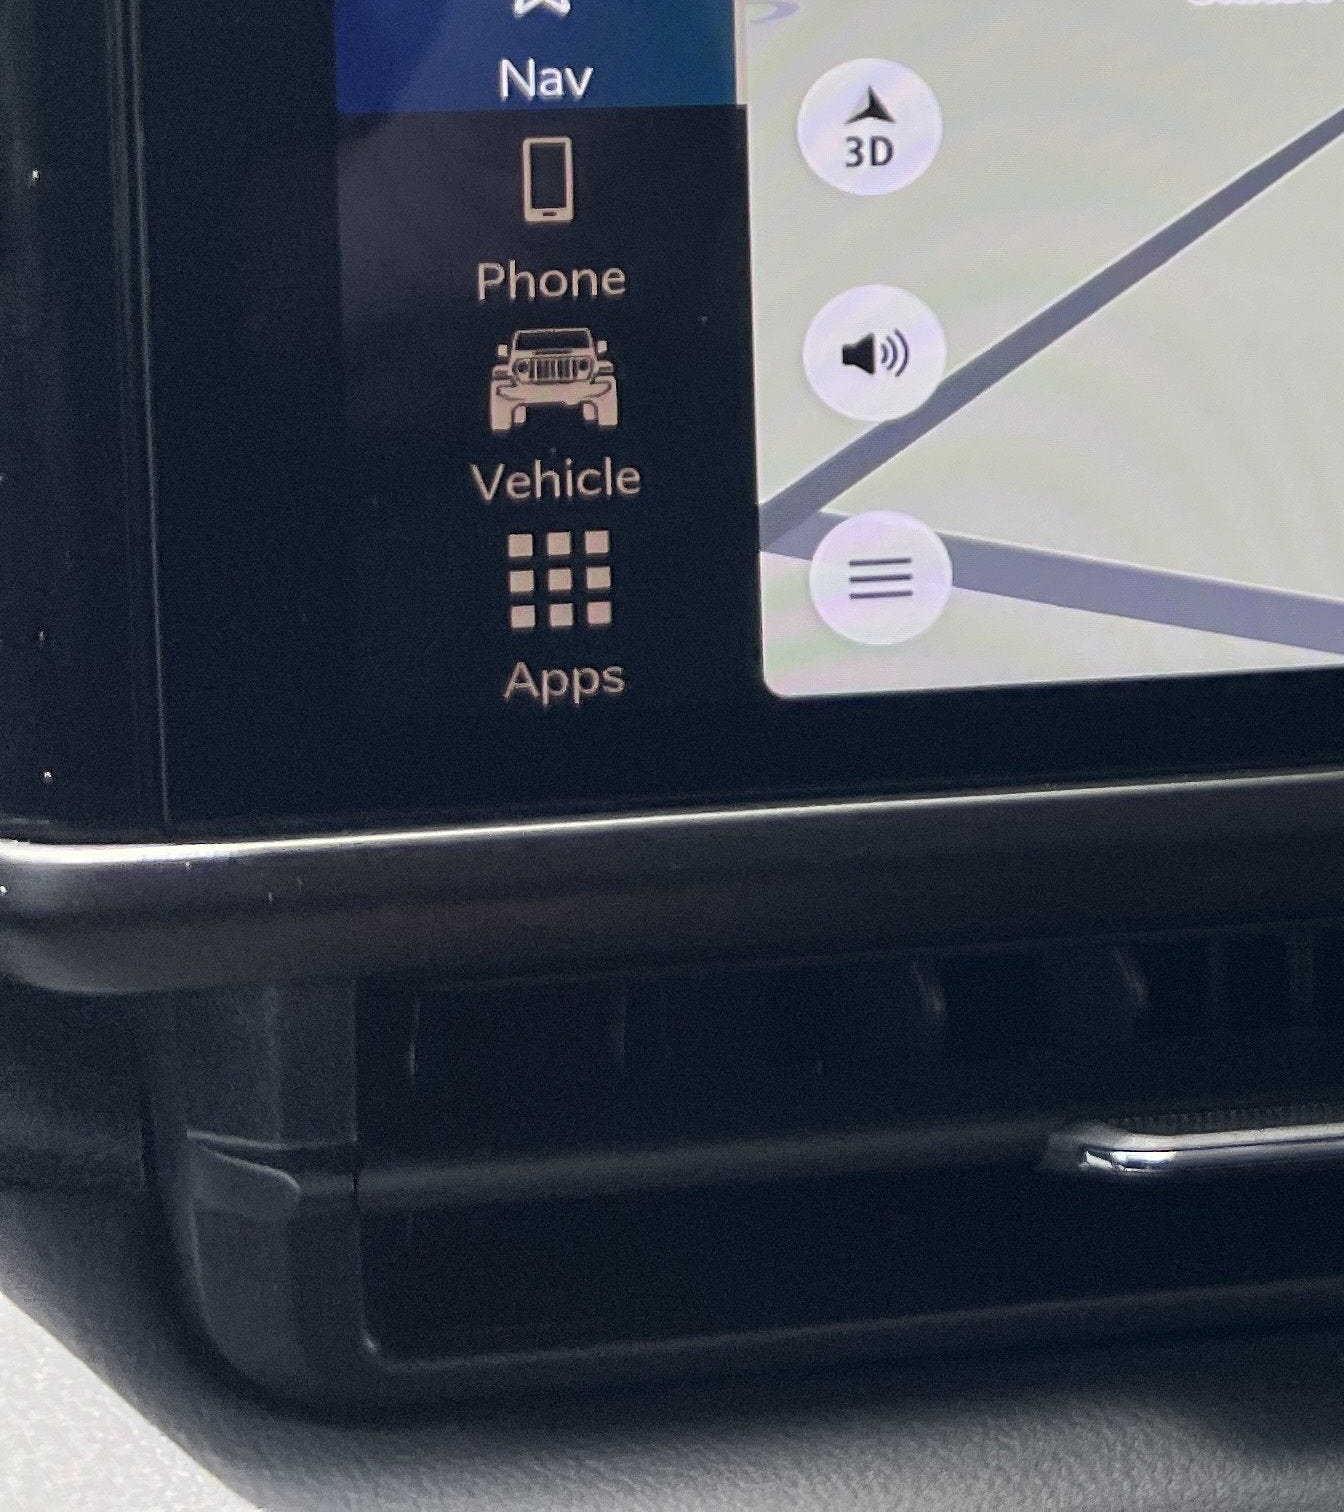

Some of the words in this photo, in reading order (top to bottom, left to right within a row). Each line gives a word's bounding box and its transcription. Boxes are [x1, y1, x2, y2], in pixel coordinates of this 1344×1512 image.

[499, 59, 593, 101] Nav
[844, 134, 895, 169] 3D
[476, 259, 627, 302] Phone
[470, 459, 643, 500] Vehicle
[503, 660, 626, 707] Apps
